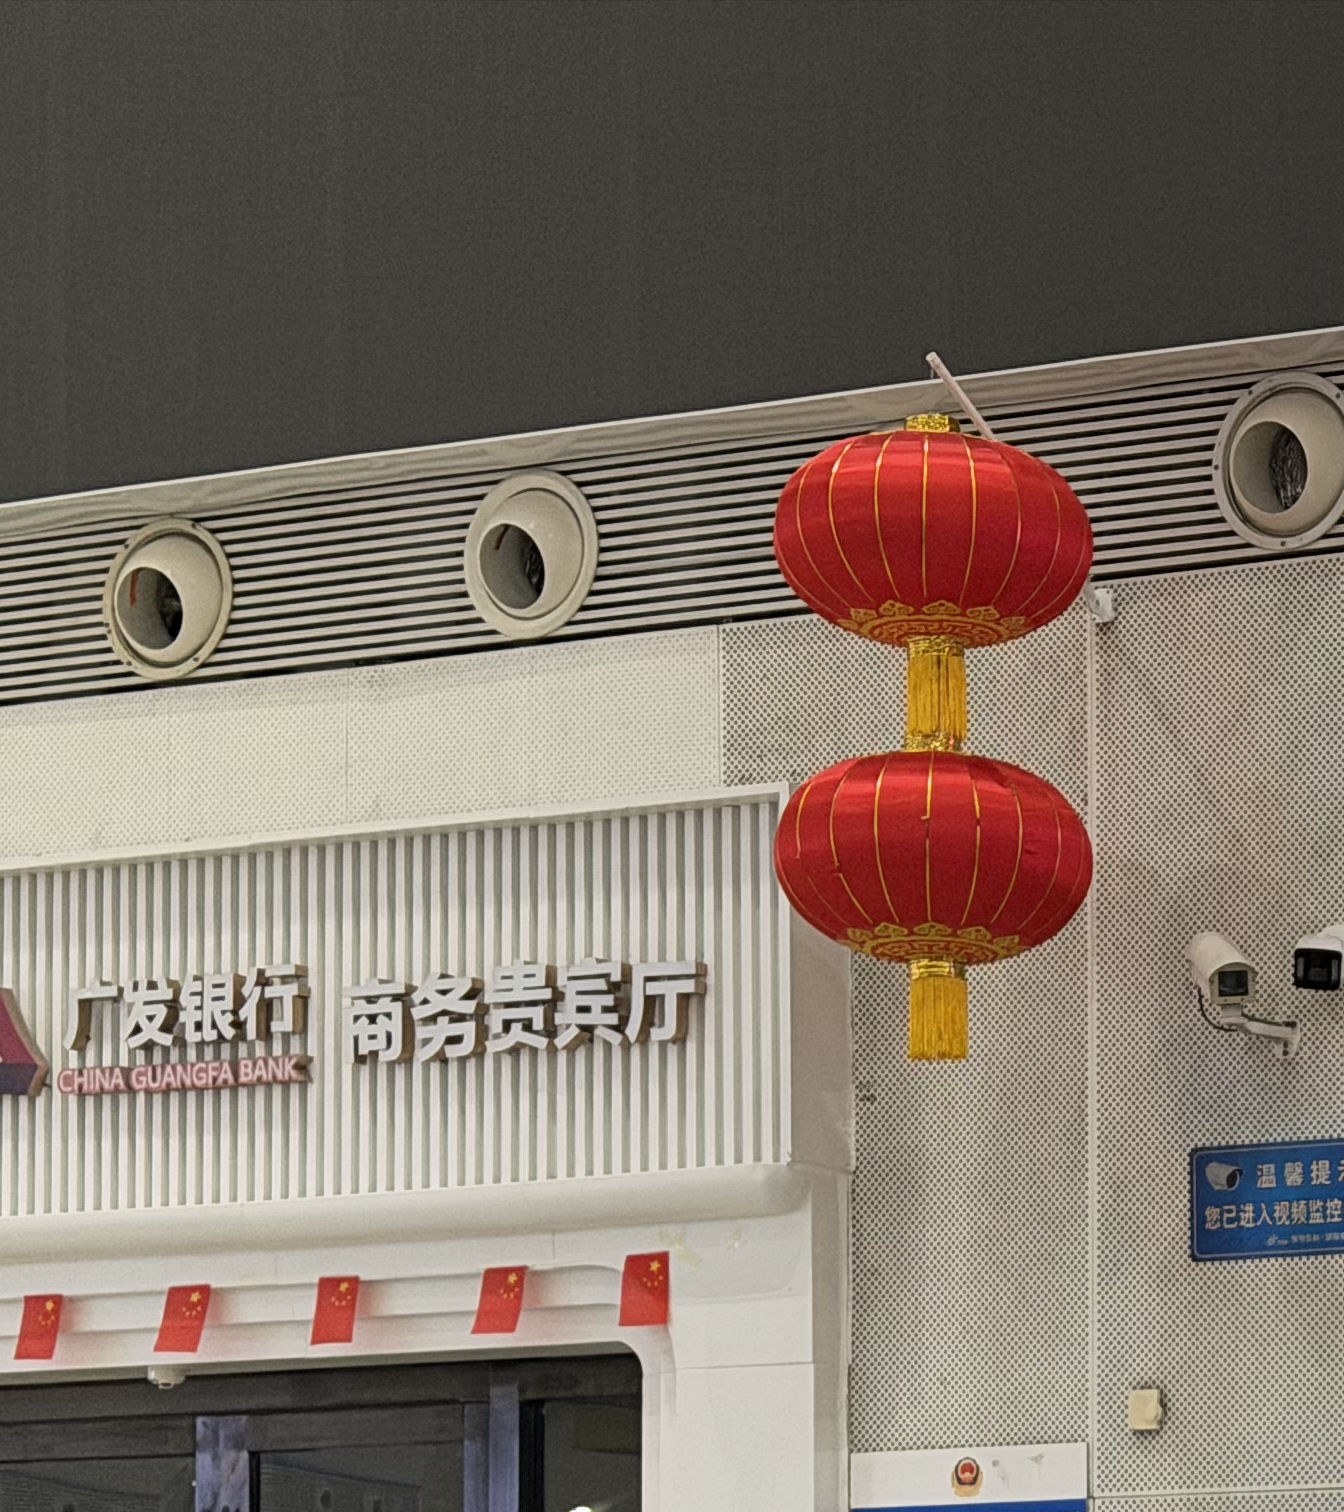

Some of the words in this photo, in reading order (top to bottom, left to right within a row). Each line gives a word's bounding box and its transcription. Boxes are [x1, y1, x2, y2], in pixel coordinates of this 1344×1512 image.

[62, 963, 312, 1052] 广发银行
[343, 957, 708, 1066] 商务贵宾厅
[57, 1067, 127, 1096] CHINA
[130, 1060, 238, 1091] GUANGFA
[237, 1055, 302, 1084] BANK
